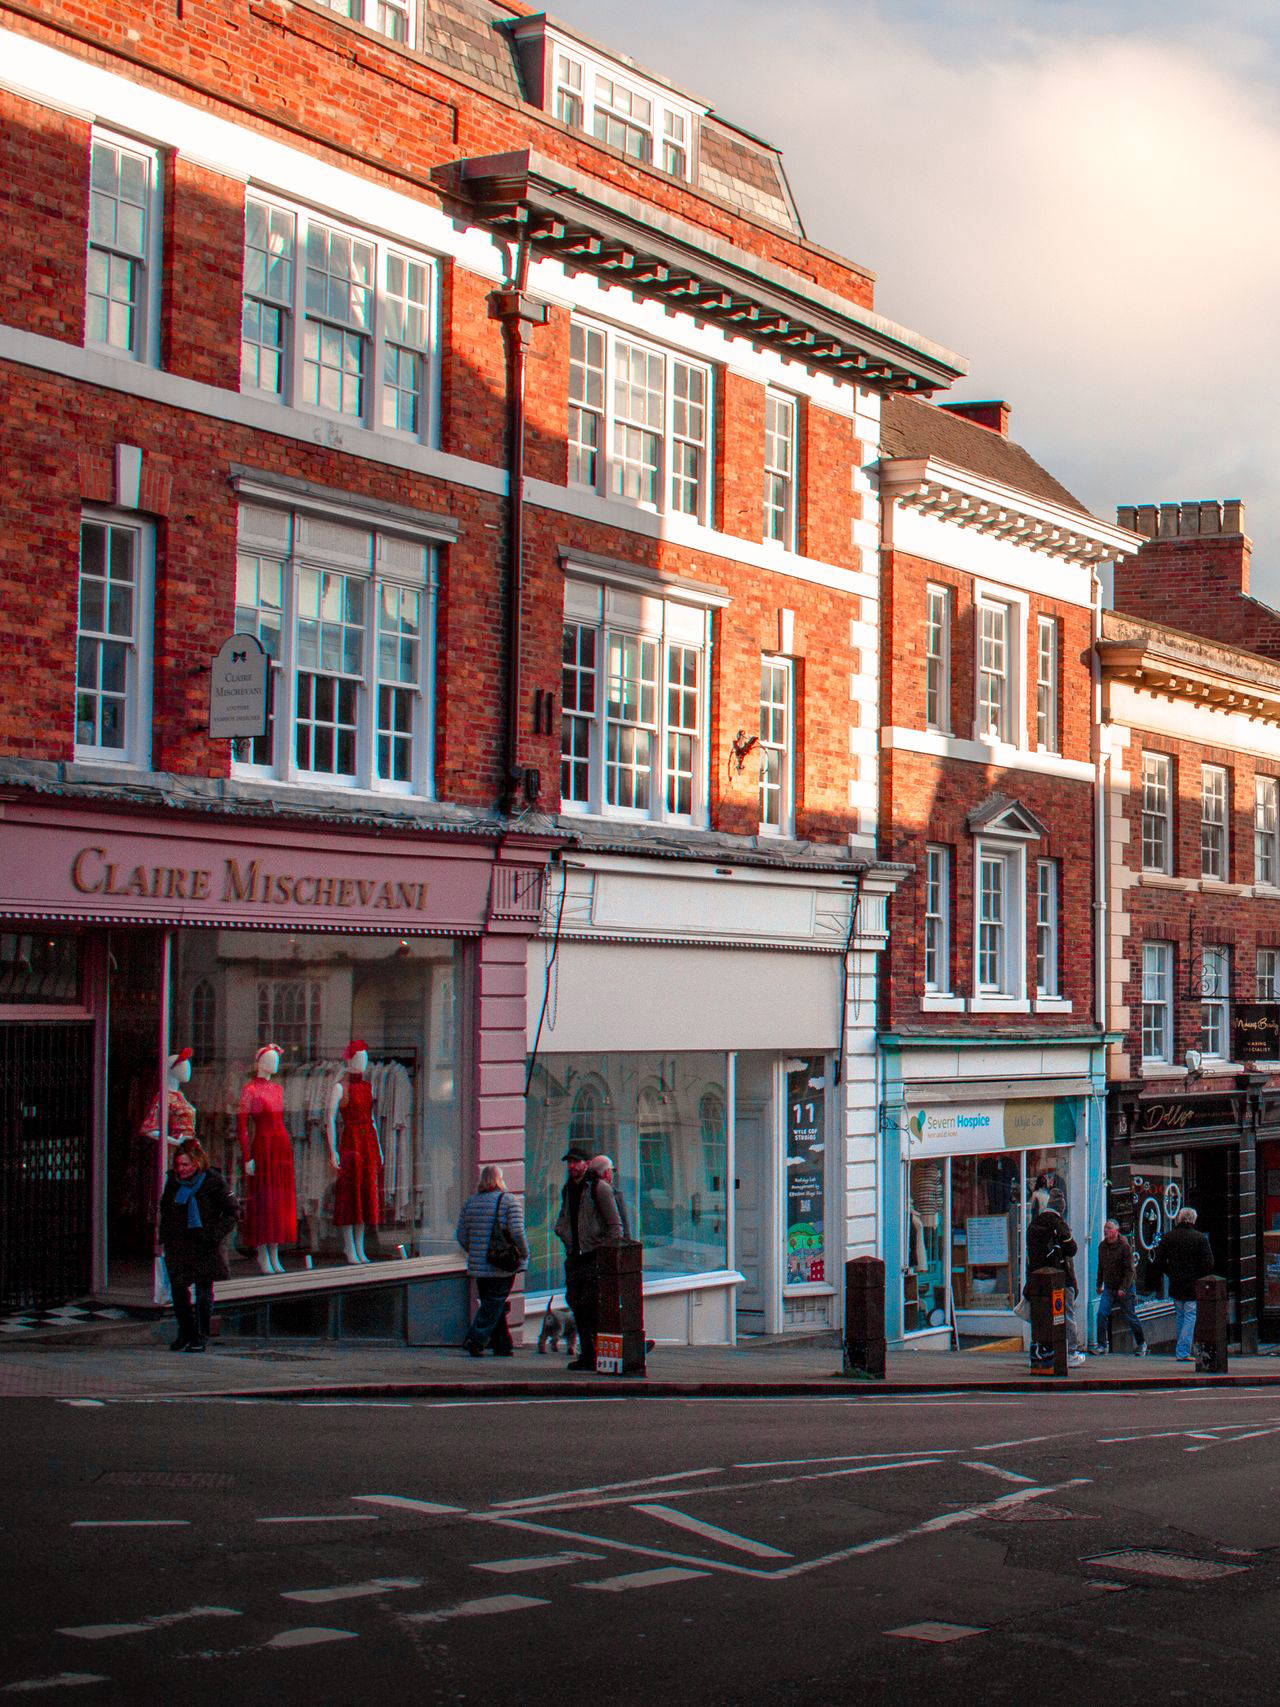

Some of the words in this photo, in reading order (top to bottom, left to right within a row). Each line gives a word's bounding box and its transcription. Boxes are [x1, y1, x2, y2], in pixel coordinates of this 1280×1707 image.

[70, 846, 211, 899] CLAIRE
[219, 856, 430, 911] MISCHEVANI
[793, 1103, 816, 1124] 11
[928, 1116, 955, 1130] Severn
[957, 1113, 990, 1129] Hospice
